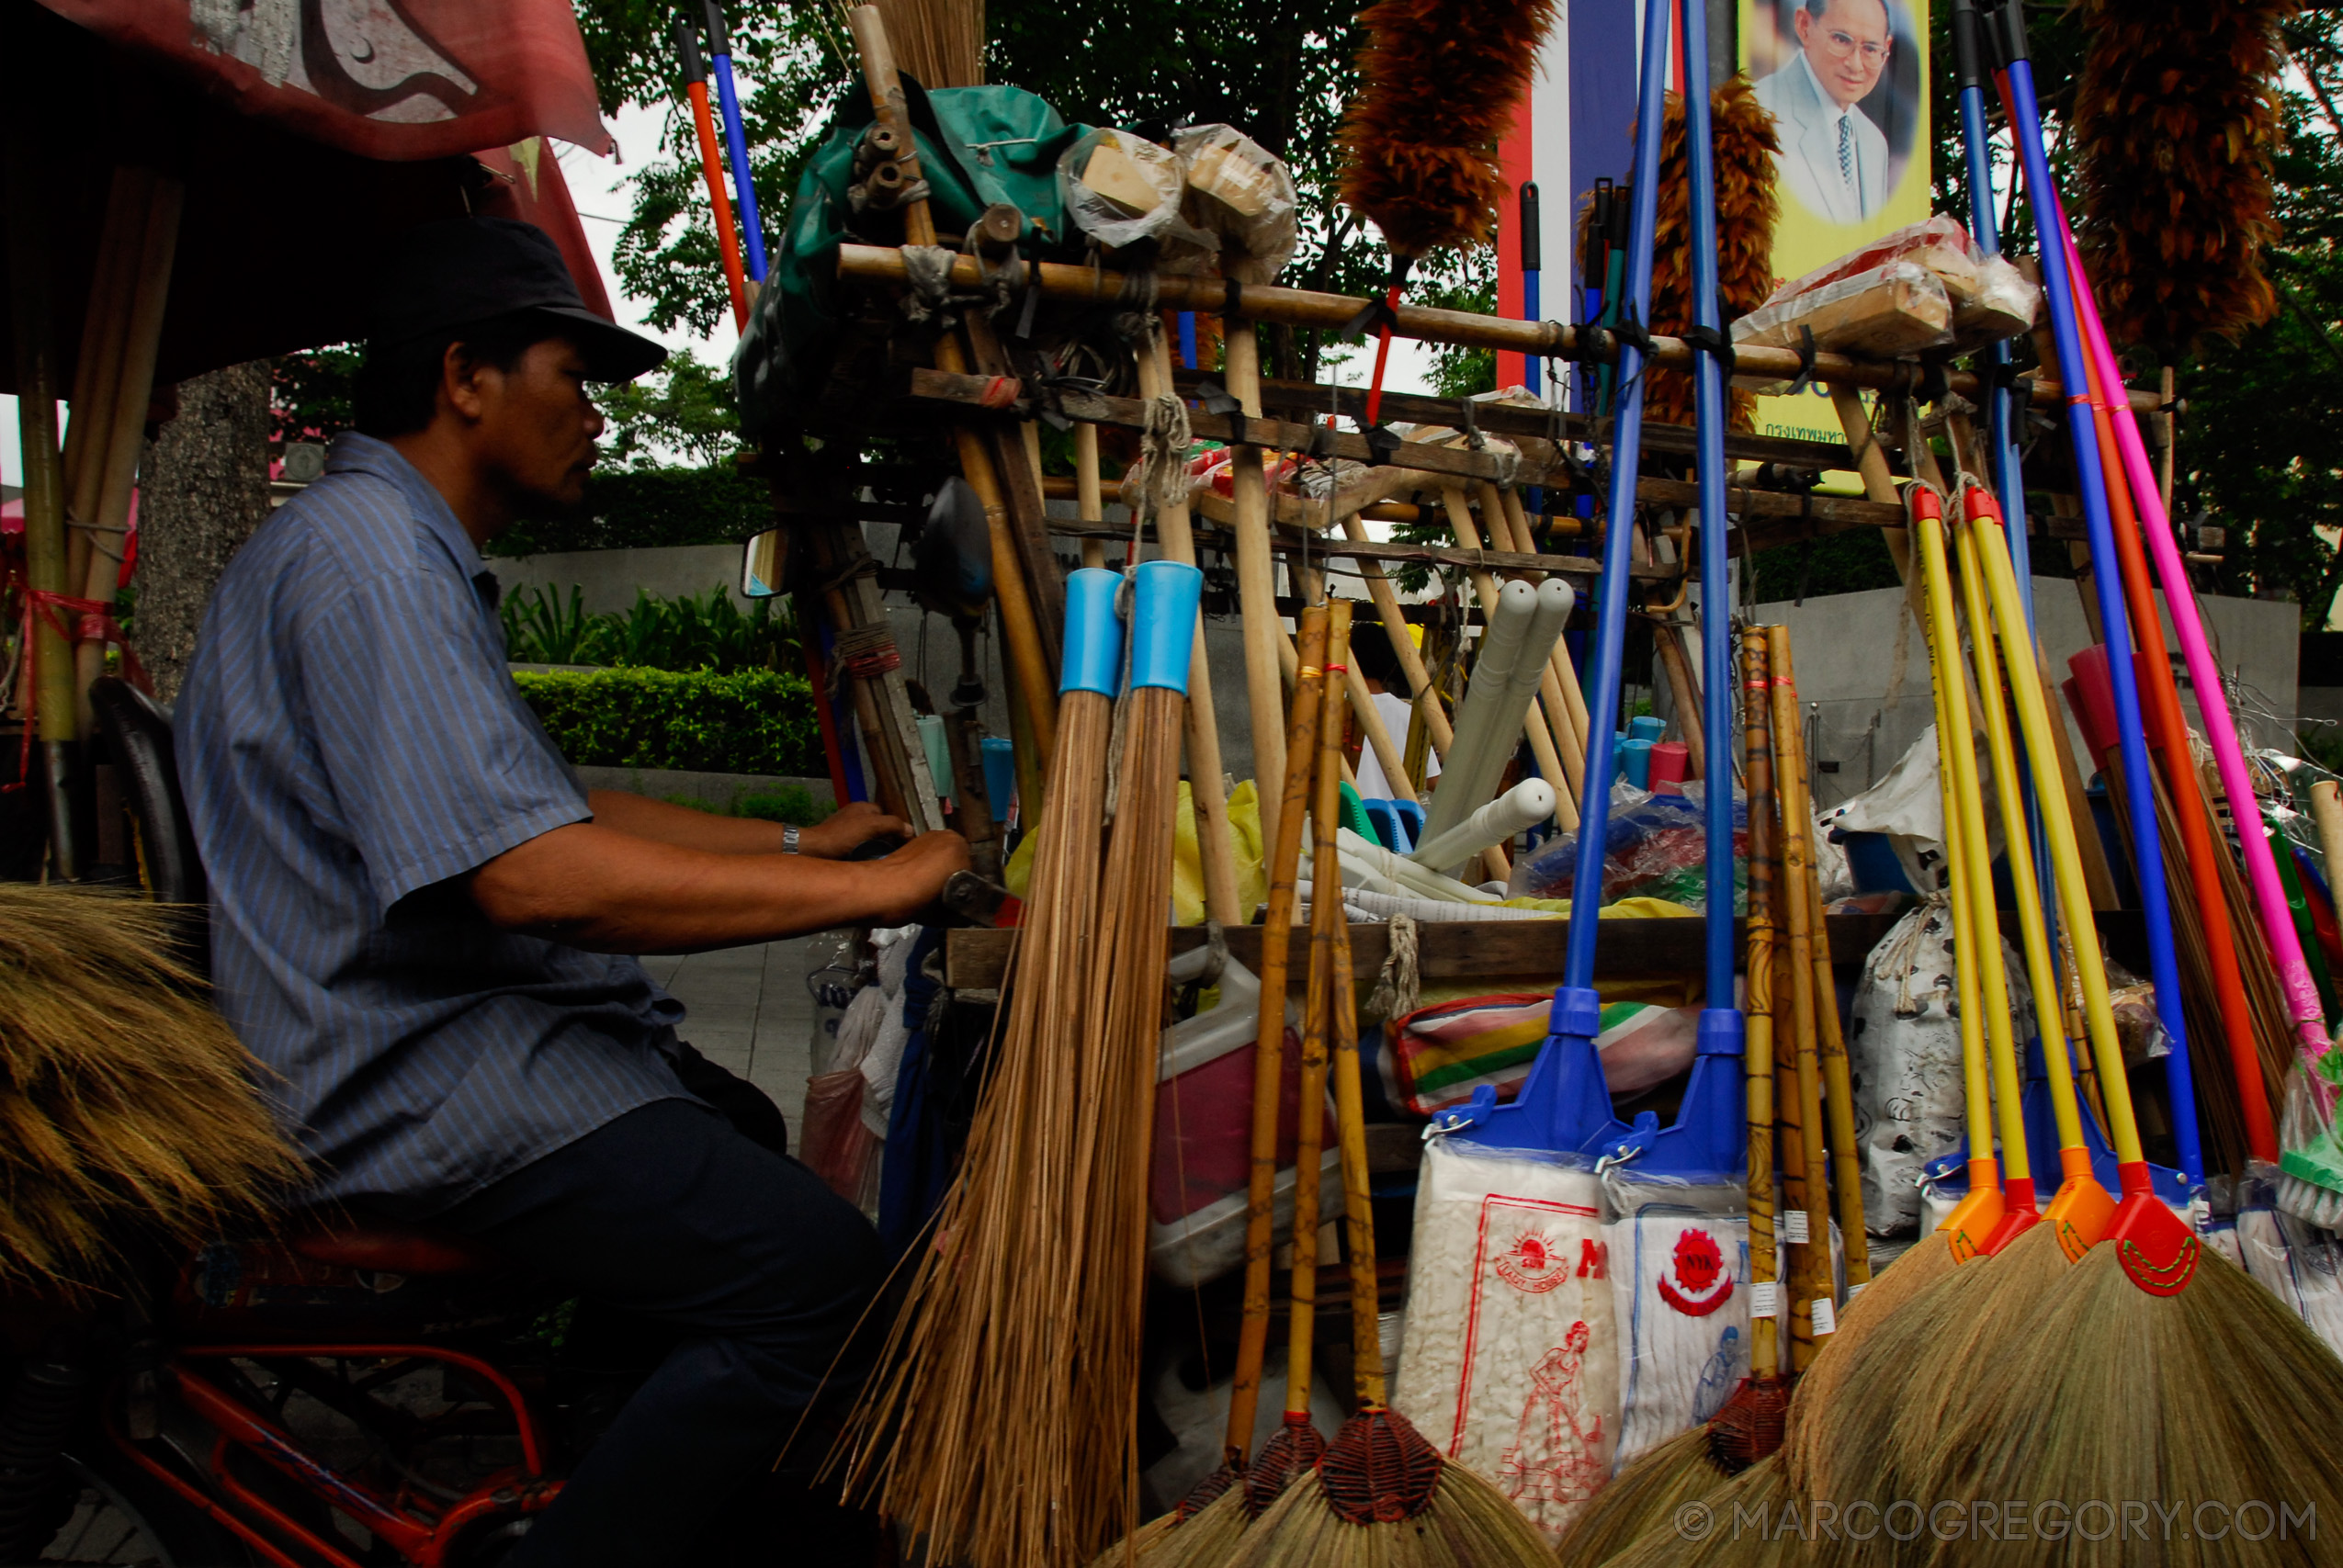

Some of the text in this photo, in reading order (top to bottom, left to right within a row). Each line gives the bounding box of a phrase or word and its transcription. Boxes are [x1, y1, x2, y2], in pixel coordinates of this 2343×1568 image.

[1522, 1258, 1545, 1269] SUN
[1500, 1266, 1564, 1291] LADY HOUSE
